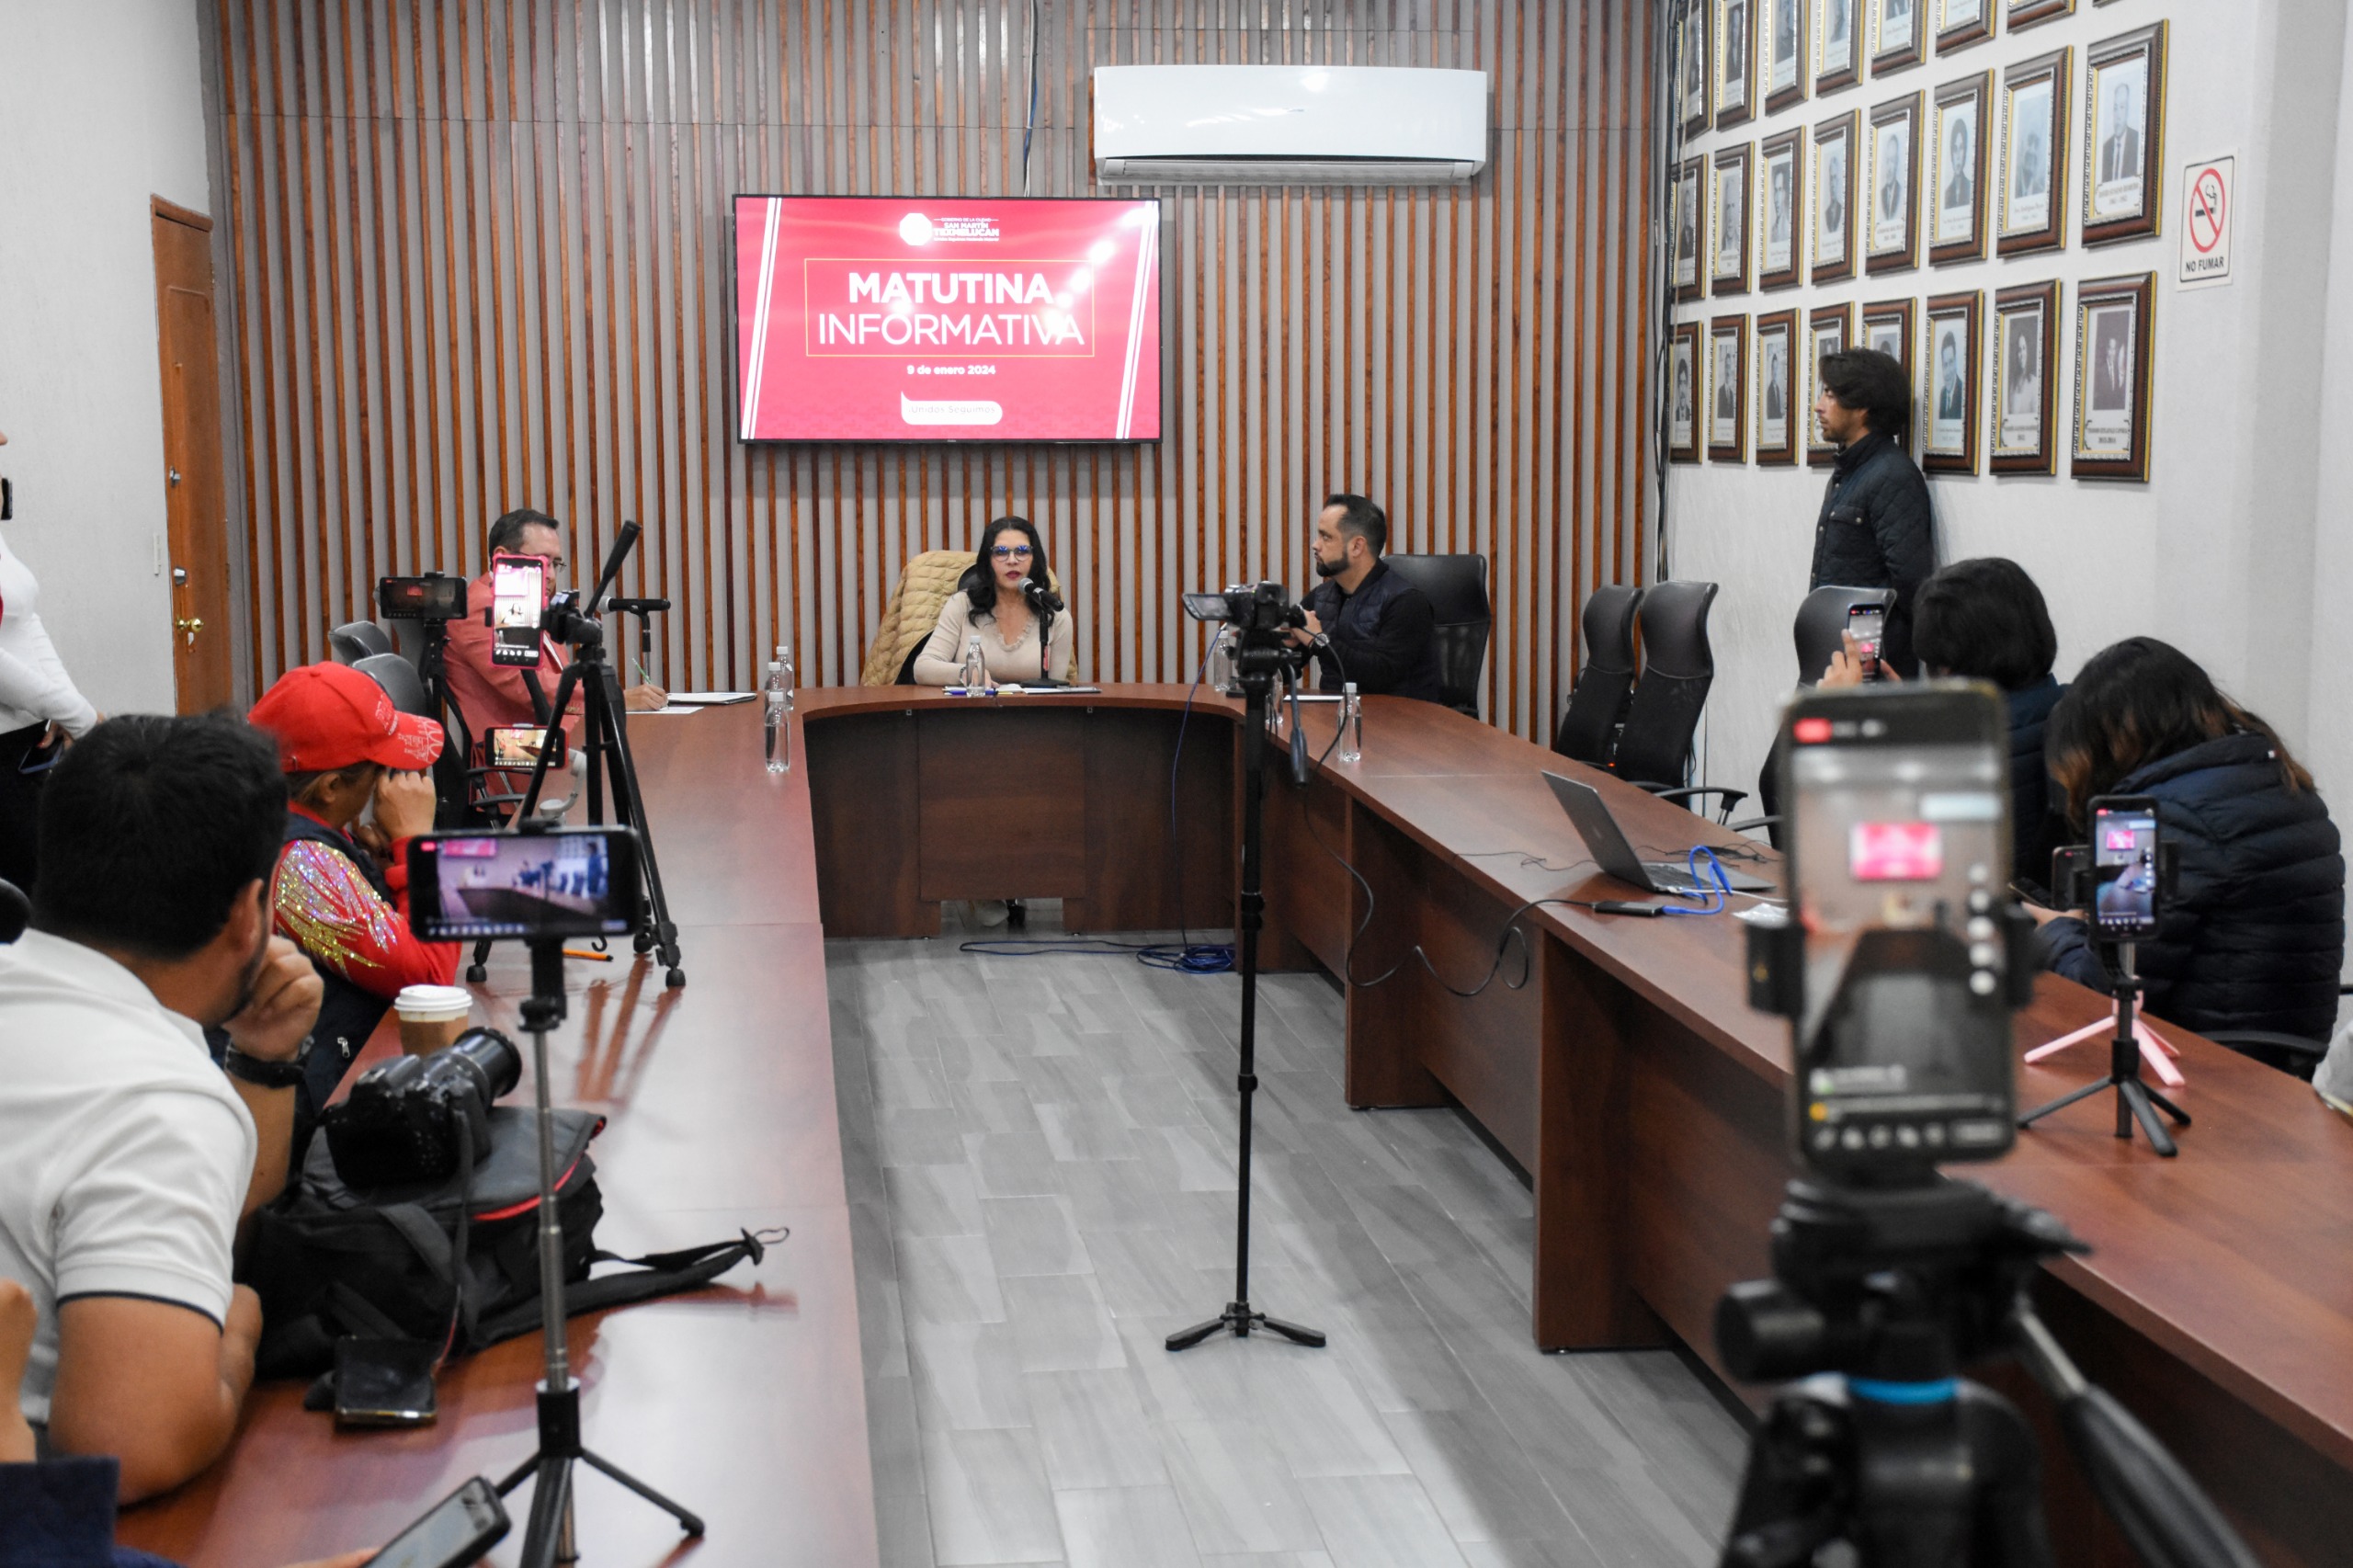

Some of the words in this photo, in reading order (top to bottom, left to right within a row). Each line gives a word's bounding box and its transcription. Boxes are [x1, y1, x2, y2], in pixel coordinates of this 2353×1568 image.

[2186, 260, 2197, 272] NO
[2198, 256, 2224, 272] FUMAR
[848, 272, 1054, 304] MATUTINA
[819, 313, 1086, 346] INFORMATIVA
[906, 365, 915, 375] 9
[916, 365, 932, 375] de
[933, 366, 966, 375] enero
[967, 365, 996, 375] 2024
[948, 405, 995, 415] Seguimos
